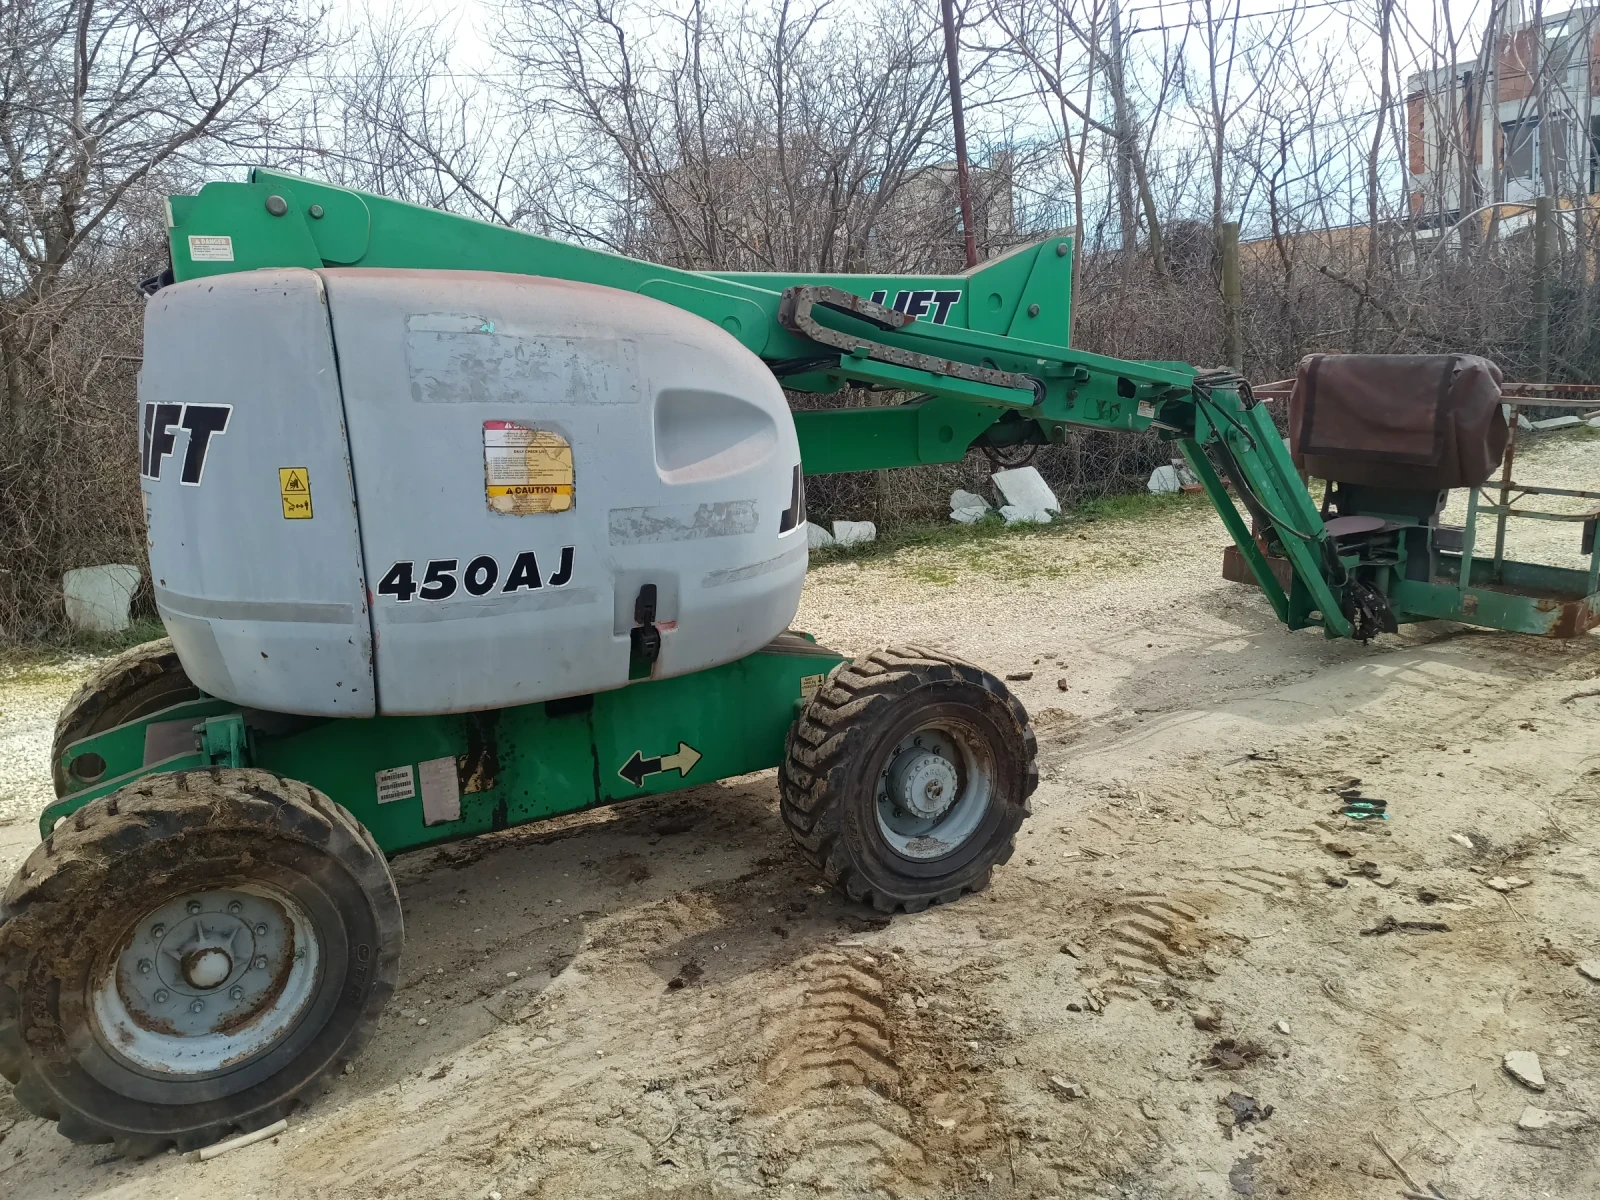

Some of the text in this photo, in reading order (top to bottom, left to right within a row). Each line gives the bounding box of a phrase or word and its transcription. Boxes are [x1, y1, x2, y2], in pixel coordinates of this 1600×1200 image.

[138, 400, 234, 487] IFT
[514, 486, 558, 495] CAUTION
[376, 545, 576, 603] 450AJ
